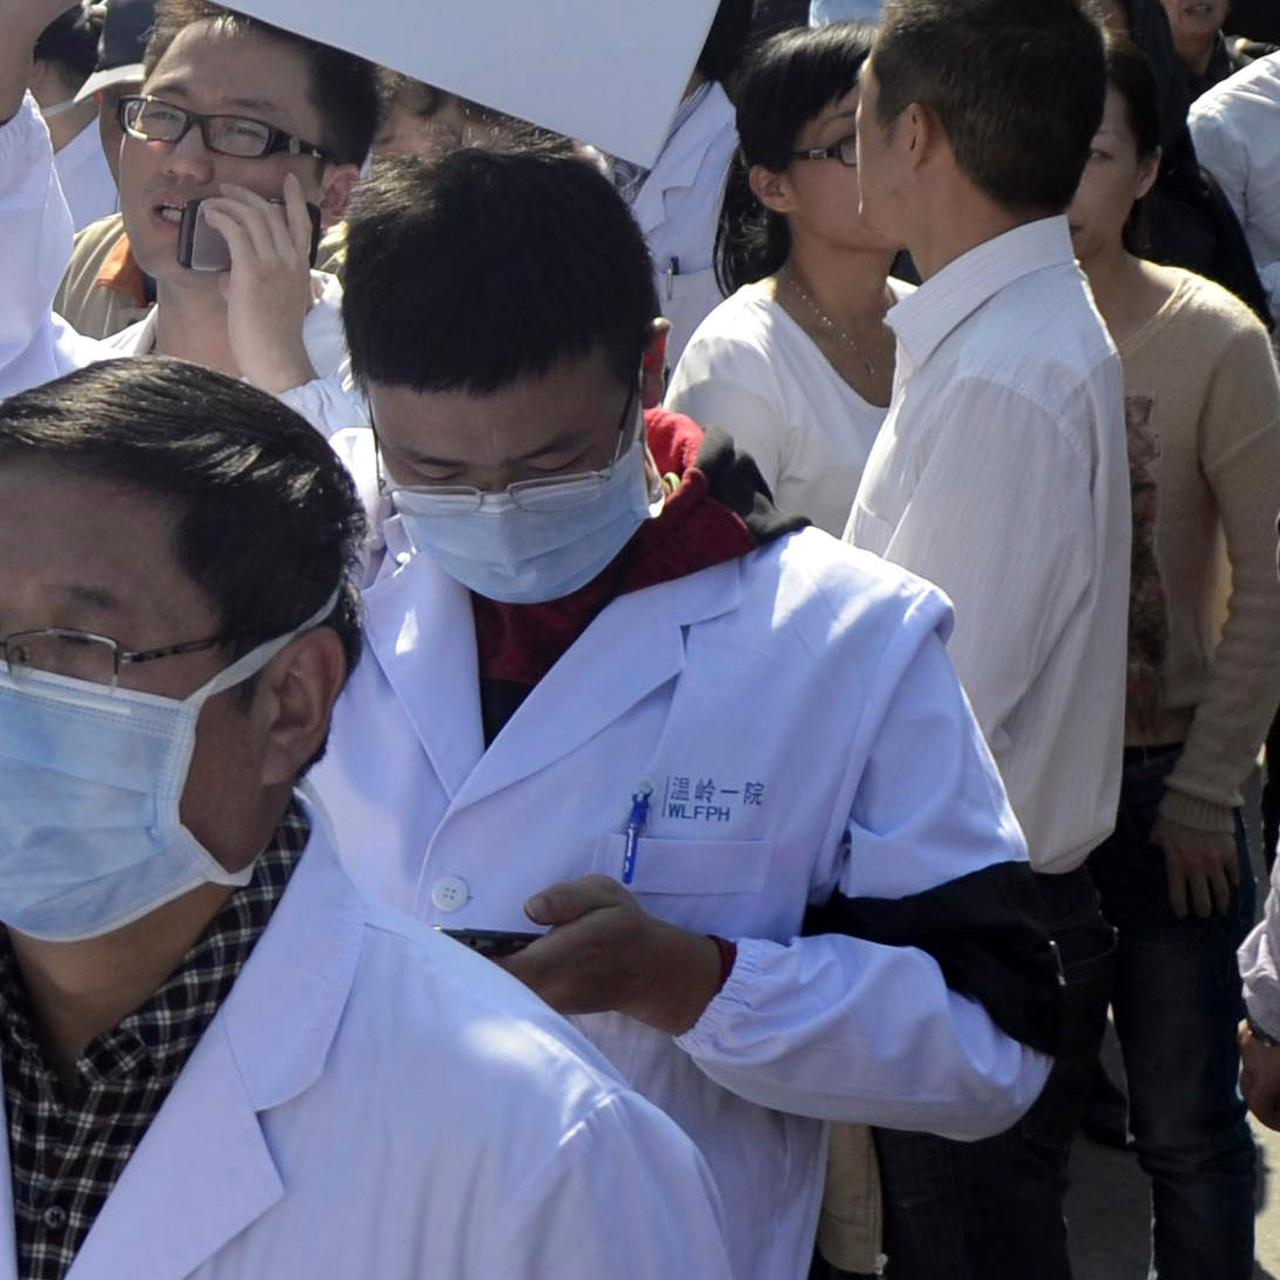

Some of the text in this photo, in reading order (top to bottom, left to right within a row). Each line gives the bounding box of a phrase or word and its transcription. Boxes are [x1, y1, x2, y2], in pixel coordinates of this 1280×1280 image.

[670, 776, 765, 807] 温岭一院
[668, 806, 731, 823] WLFPH
